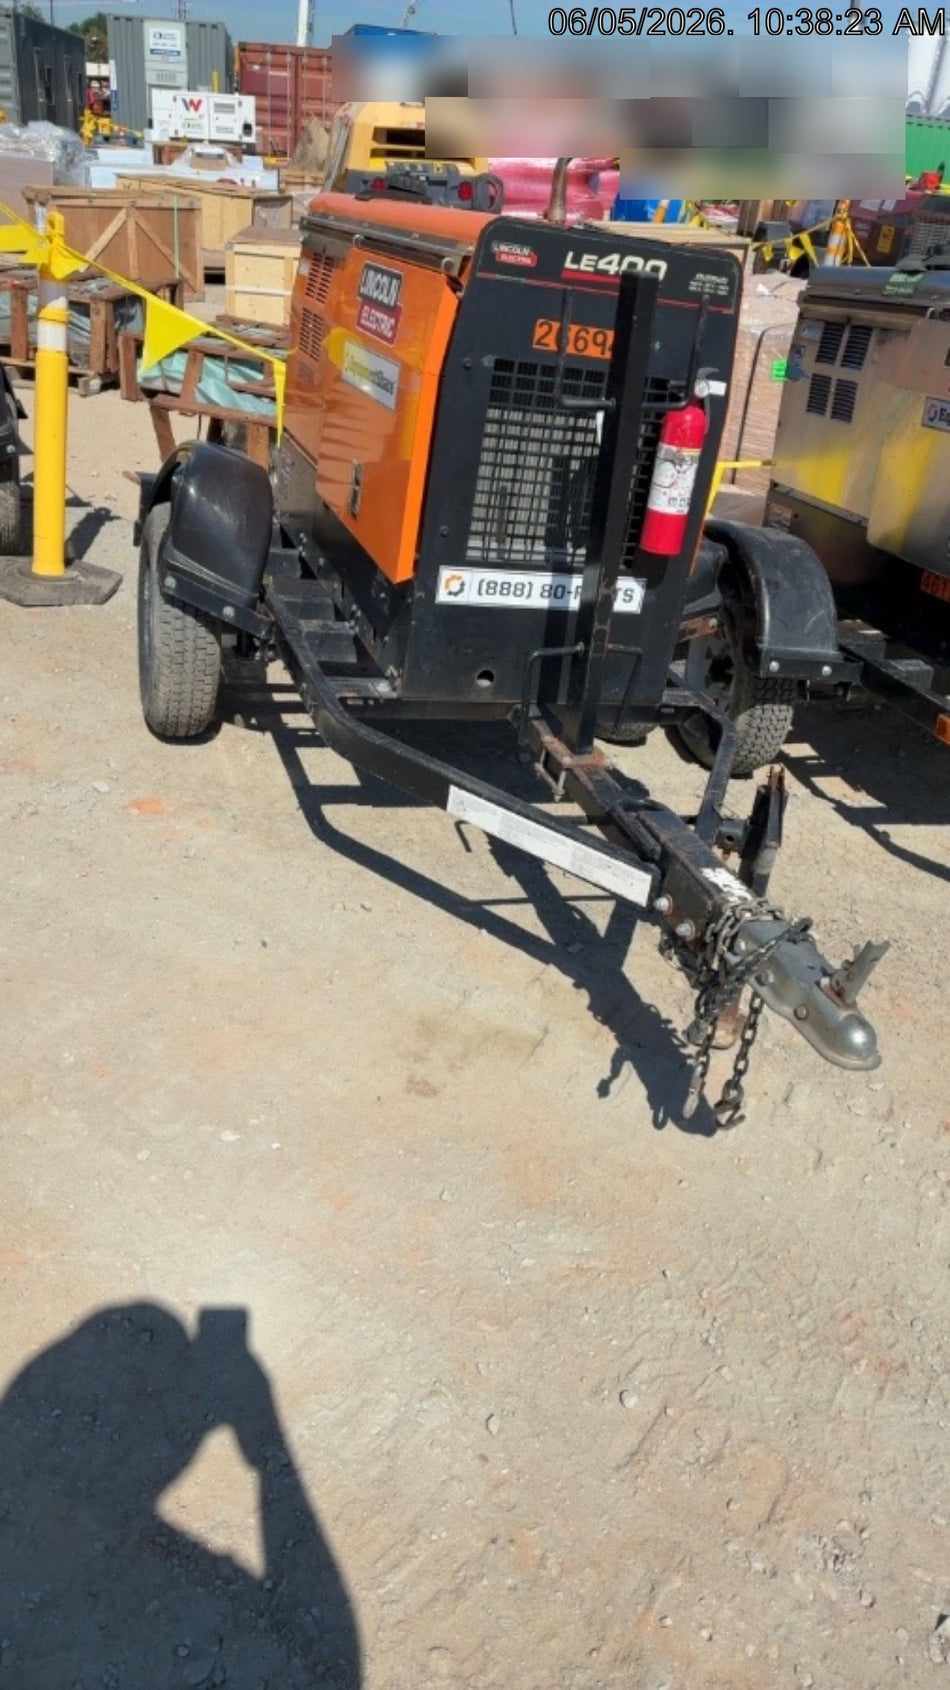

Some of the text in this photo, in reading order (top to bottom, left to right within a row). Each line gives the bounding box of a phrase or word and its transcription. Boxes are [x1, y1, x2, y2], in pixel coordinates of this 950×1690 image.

[564, 250, 668, 281] LE400
[360, 269, 400, 307] LINCOLN
[477, 578, 533, 599] (888)
